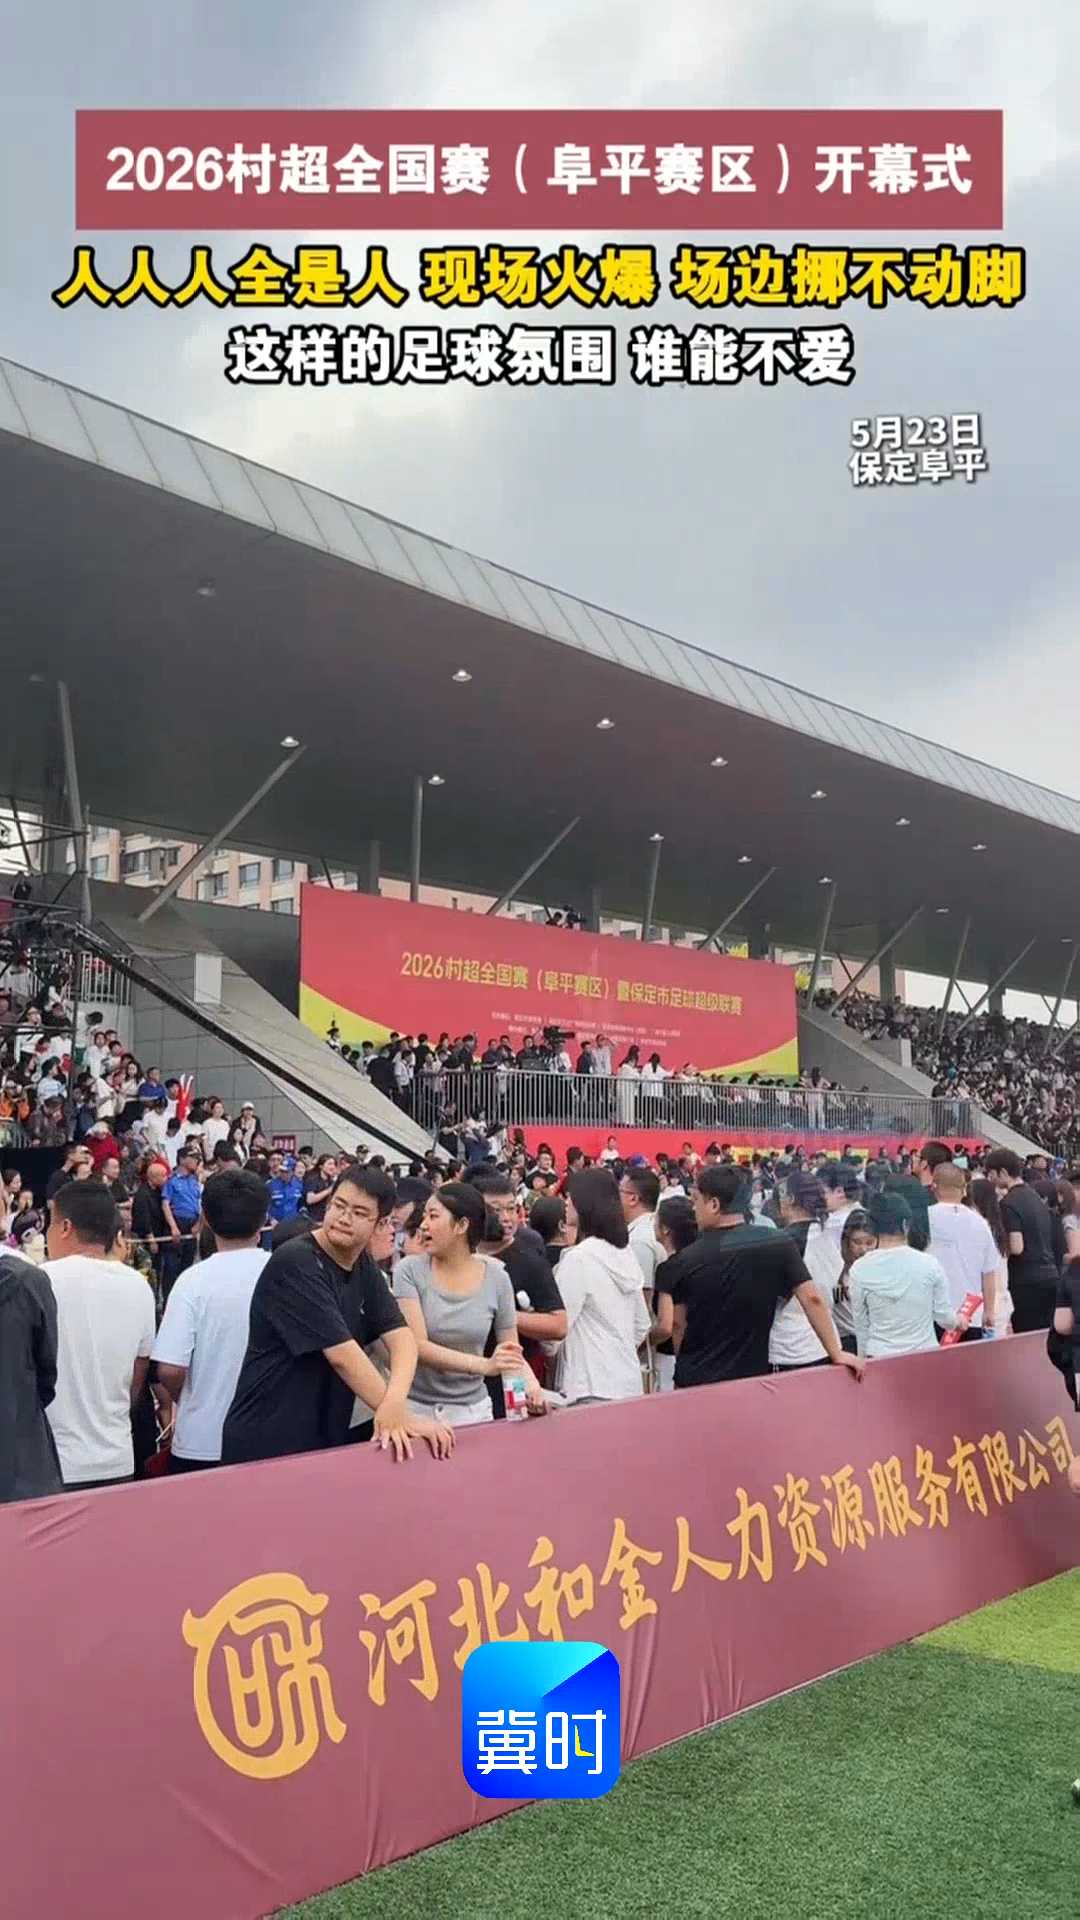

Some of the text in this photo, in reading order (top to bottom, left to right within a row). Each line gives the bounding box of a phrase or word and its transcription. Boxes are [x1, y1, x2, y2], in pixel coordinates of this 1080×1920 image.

[358, 1415, 1074, 1707] 河北和金人力资源服务有限公司
